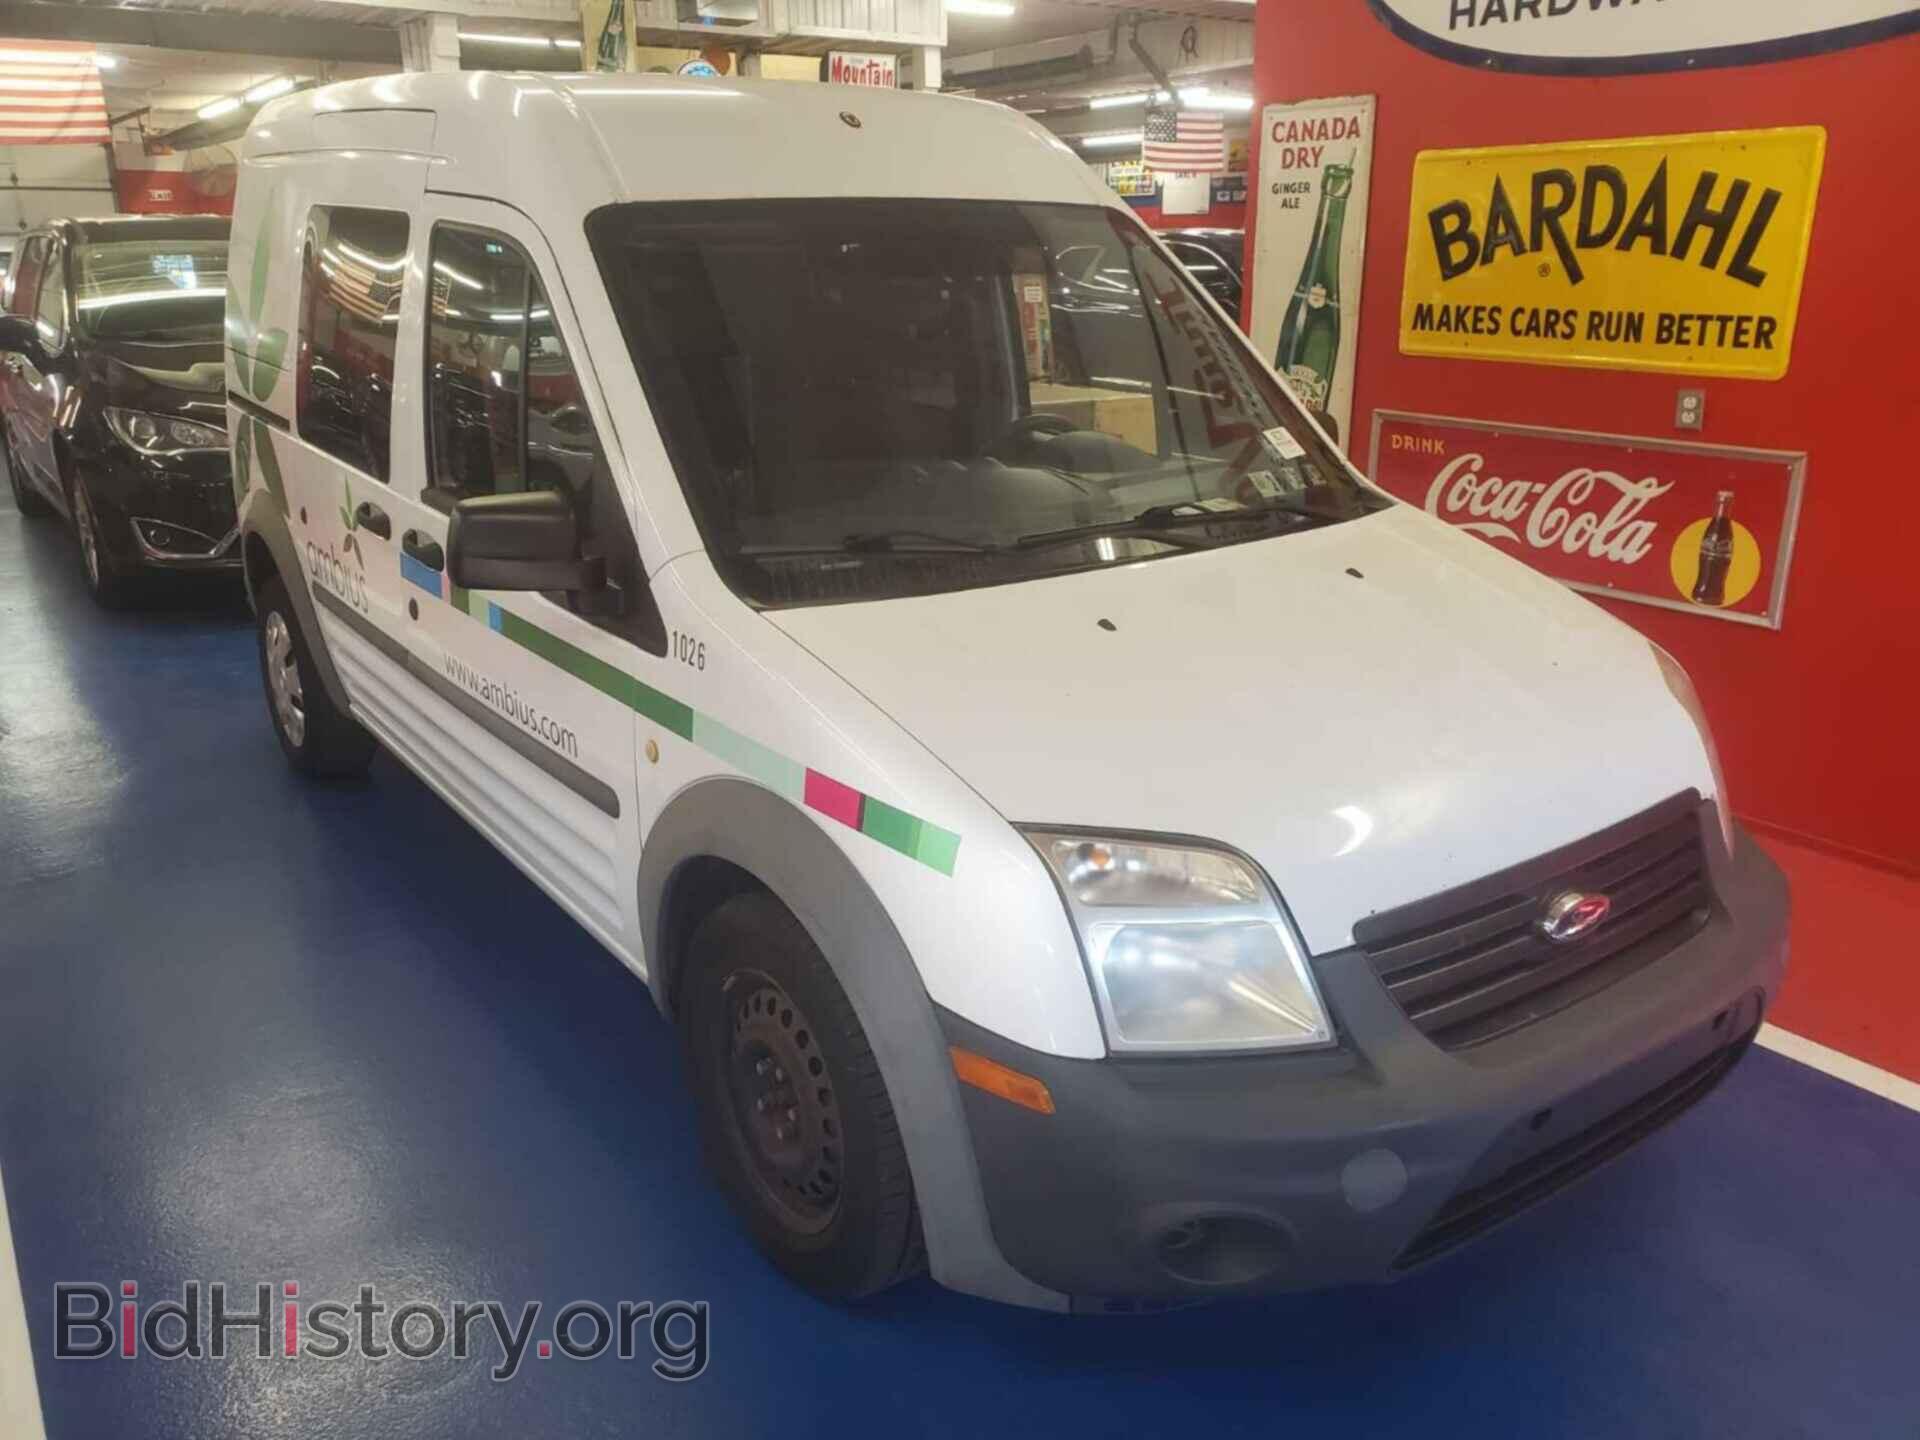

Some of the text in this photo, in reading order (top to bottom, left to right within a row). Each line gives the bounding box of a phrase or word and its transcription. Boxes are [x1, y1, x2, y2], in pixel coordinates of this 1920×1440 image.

[831, 56, 894, 88] Mountain
[1271, 116, 1361, 143] CANADA
[1281, 145, 1325, 170] DRY
[1271, 182, 1311, 195] GINGER
[1280, 197, 1301, 209] ALE
[1427, 154, 1783, 288] BARDAHL
[1411, 303, 1777, 350] MAKES CARS RUN BETTER
[1391, 434, 1446, 456] DRINK
[1425, 453, 1676, 565] Coca-Cola
[306, 540, 370, 614] ambius
[672, 630, 705, 671] 1026
[442, 651, 579, 759] www.ambius.com
